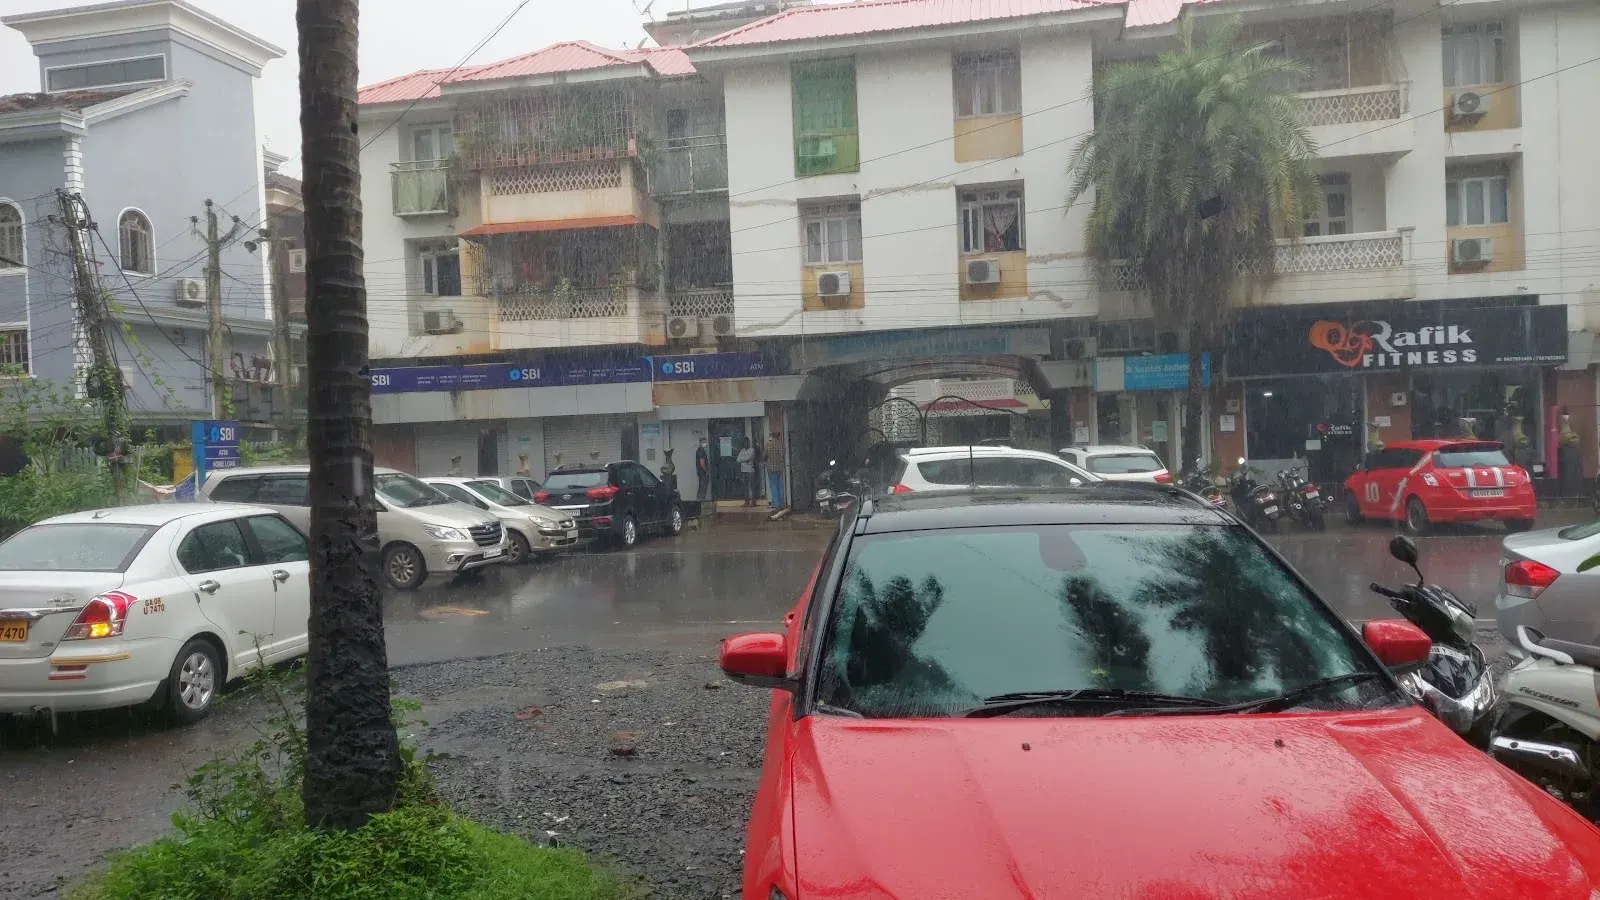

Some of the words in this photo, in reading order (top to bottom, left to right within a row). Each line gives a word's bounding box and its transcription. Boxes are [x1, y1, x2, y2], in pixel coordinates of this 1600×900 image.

[1368, 320, 1474, 353] Rafik
[1362, 349, 1477, 368] FITNESS
[521, 368, 541, 380] SBI
[674, 361, 695, 374] SBI
[371, 375, 390, 386] SBI
[220, 427, 235, 441] SBI
[1365, 481, 1380, 503] 10
[150, 603, 165, 614] 7470
